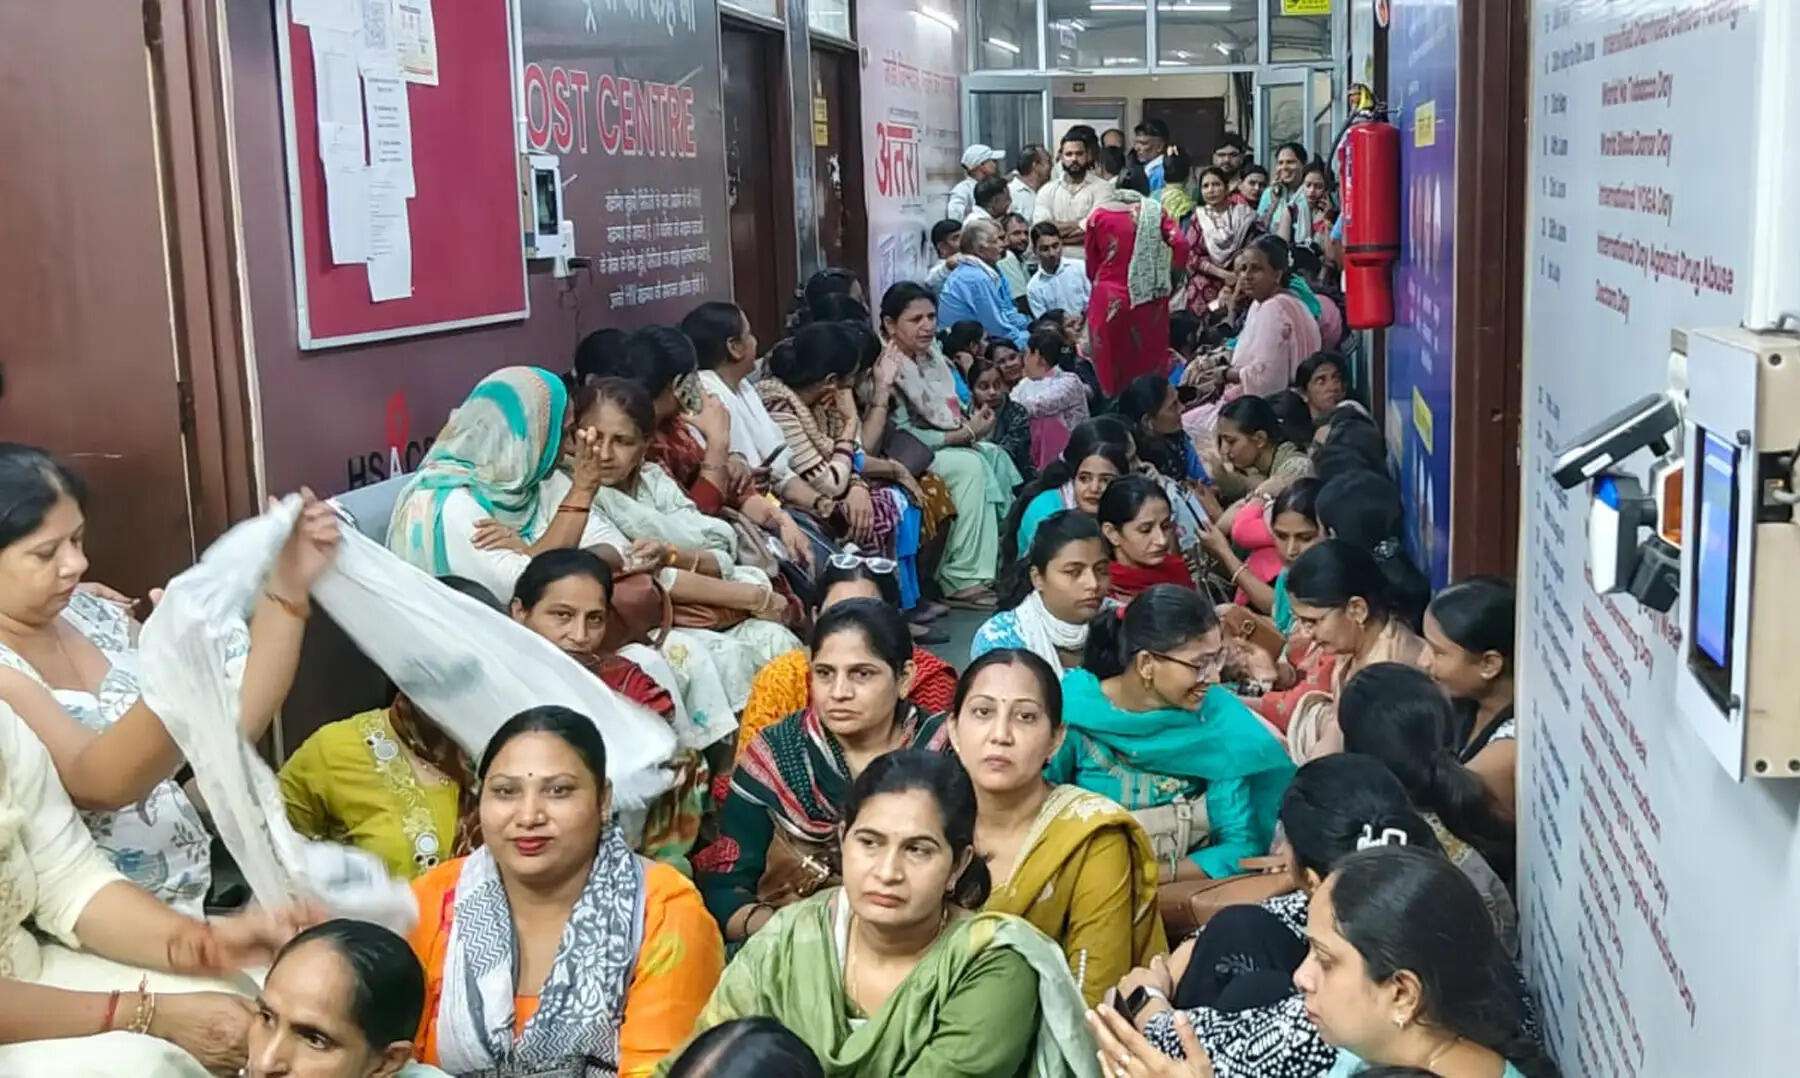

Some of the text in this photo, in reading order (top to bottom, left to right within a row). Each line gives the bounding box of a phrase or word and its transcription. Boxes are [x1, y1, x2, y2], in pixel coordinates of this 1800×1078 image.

[1658, 71, 1673, 108] Day
[526, 62, 697, 158] OST CENTRE
[1657, 129, 1672, 167] Day
[1658, 187, 1674, 227] Day
[1635, 239, 1649, 277] Day
[1650, 242, 1678, 282] Against
[1680, 251, 1701, 296] Drug
[1702, 256, 1734, 295] Abuse
[1617, 287, 1631, 324] Day
